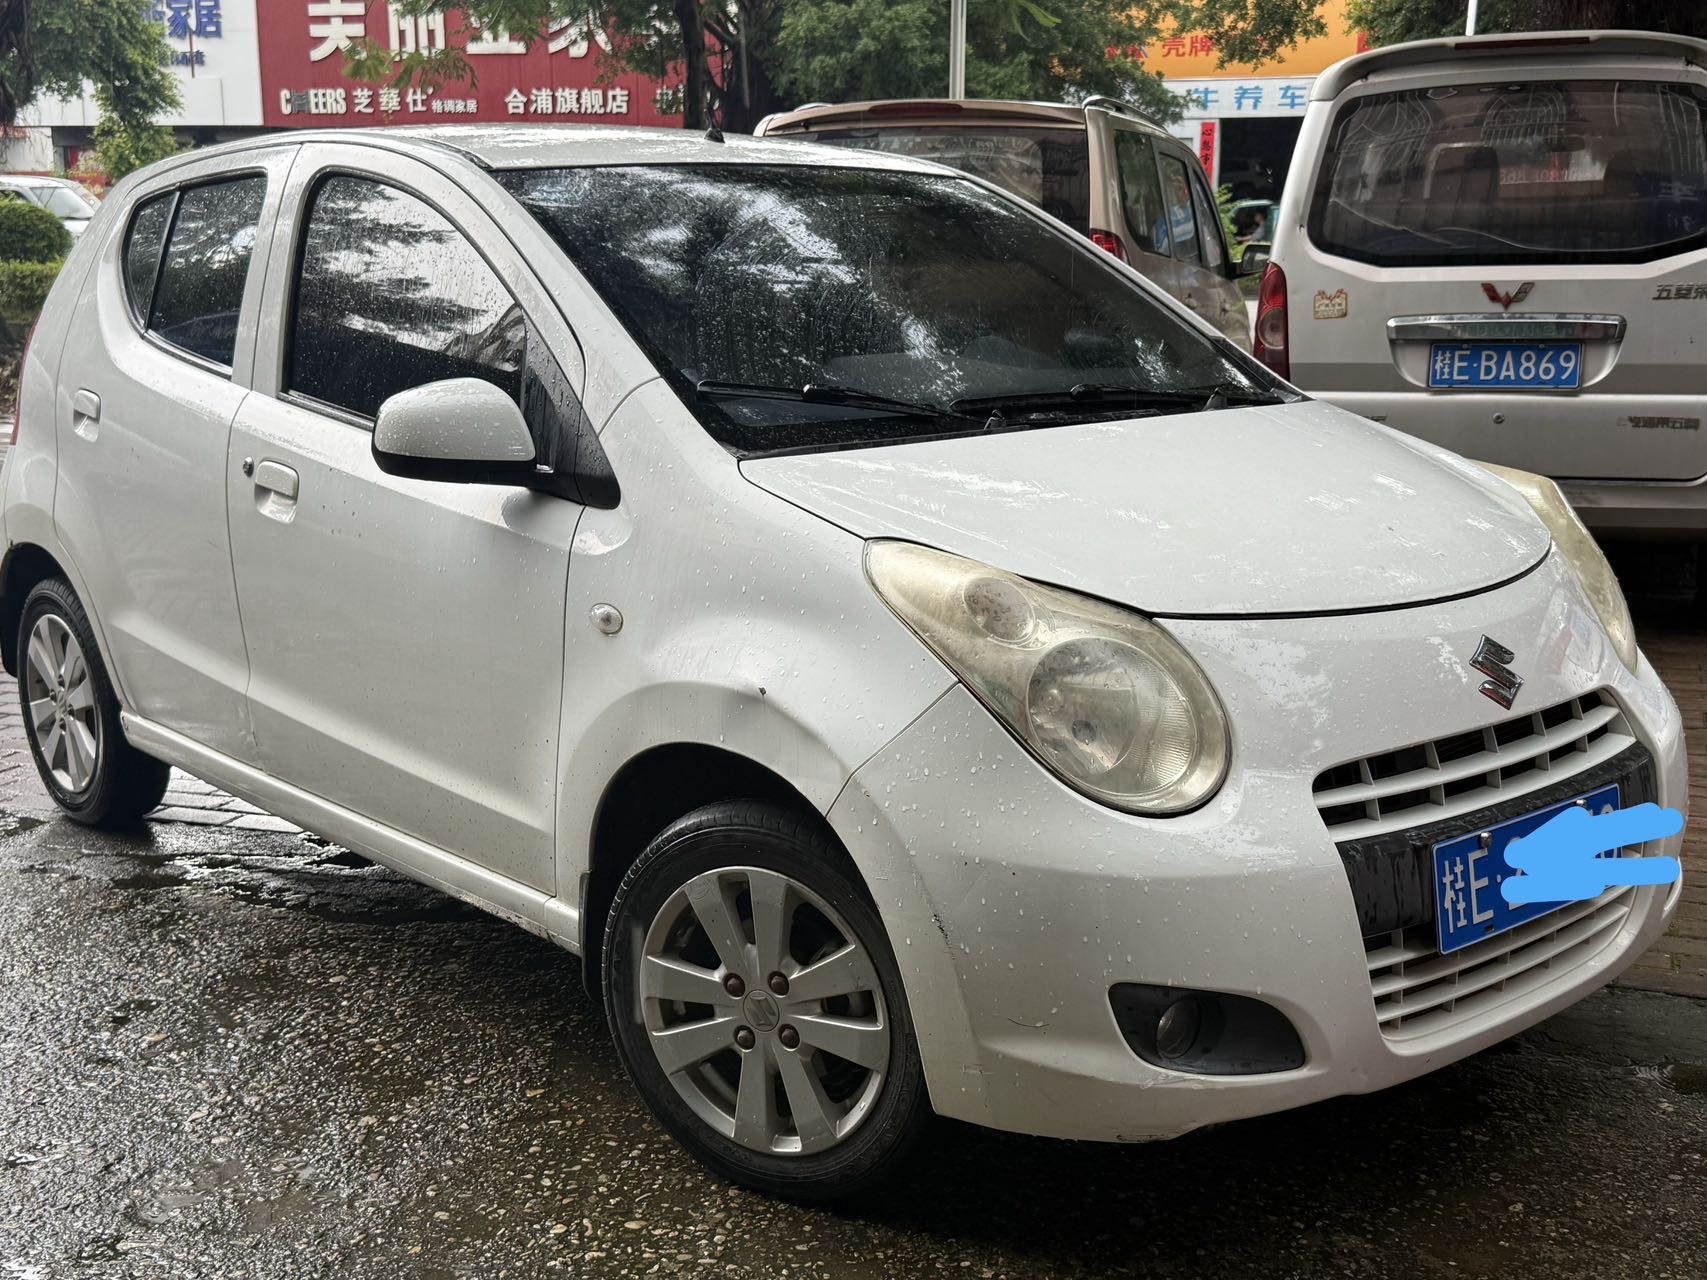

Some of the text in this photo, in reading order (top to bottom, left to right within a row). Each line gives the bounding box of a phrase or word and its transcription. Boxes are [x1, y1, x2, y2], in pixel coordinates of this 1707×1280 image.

[505, 87, 629, 114] 合浦旗舰店
